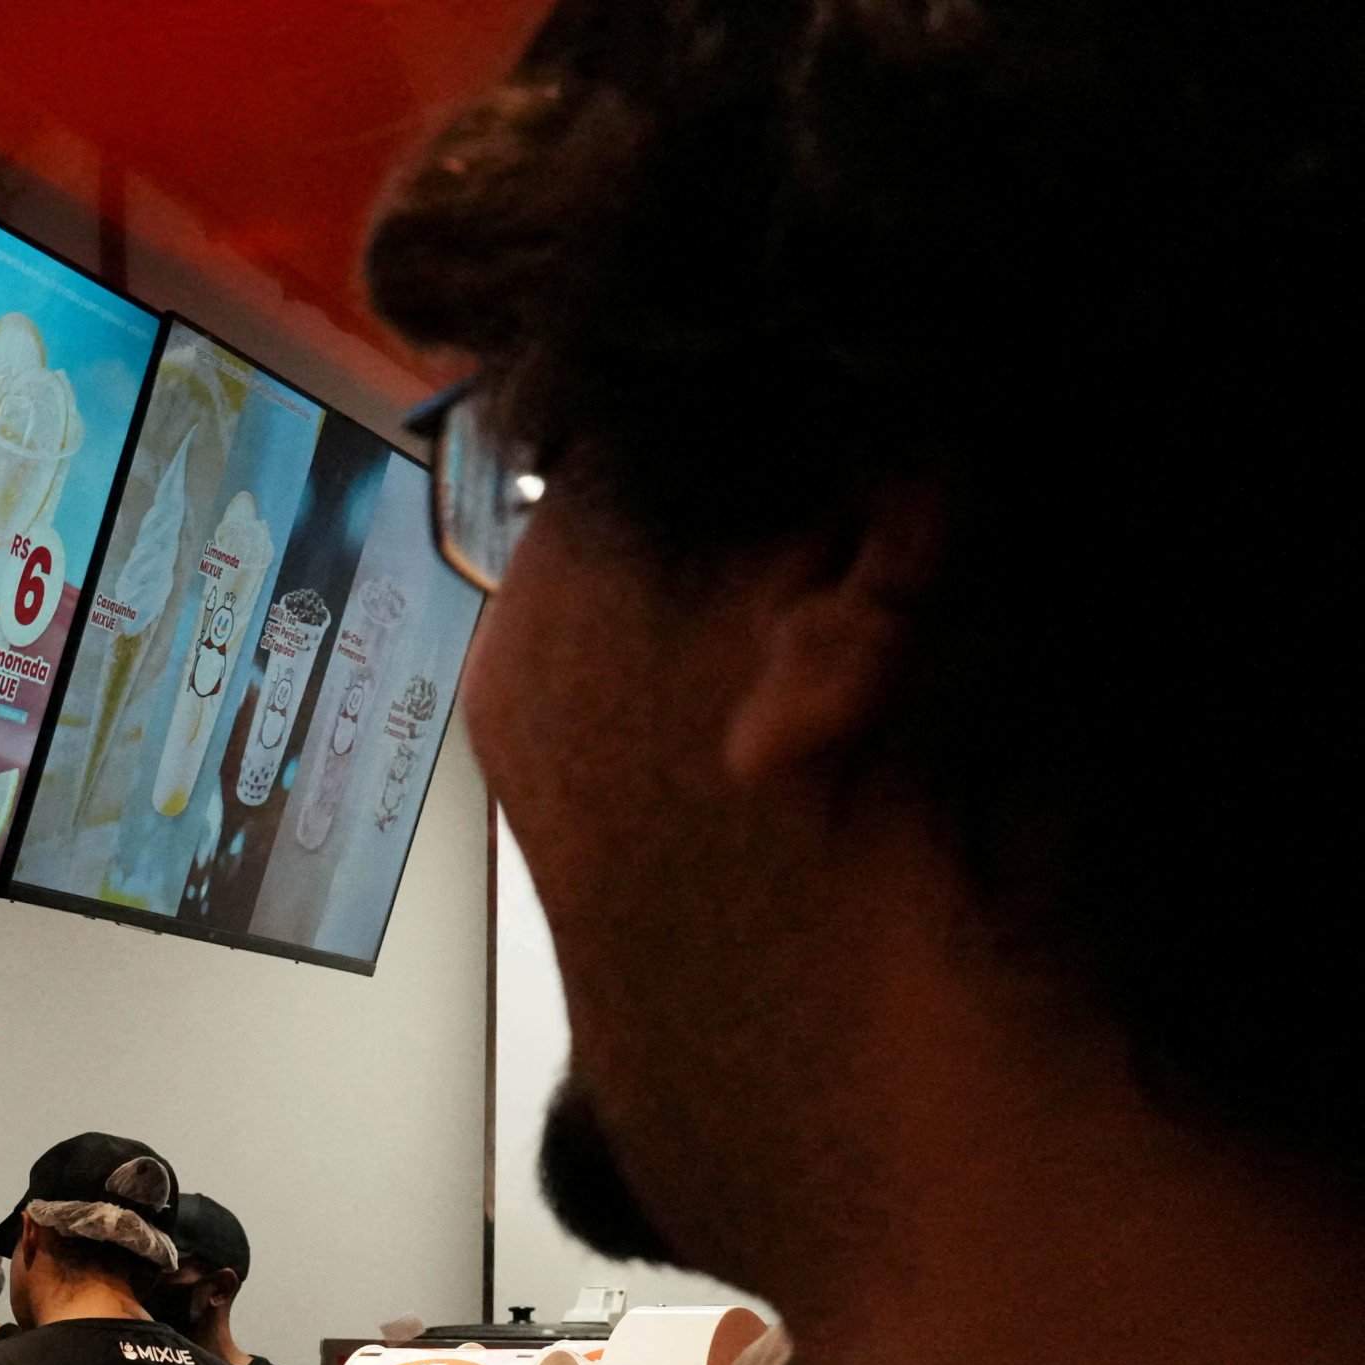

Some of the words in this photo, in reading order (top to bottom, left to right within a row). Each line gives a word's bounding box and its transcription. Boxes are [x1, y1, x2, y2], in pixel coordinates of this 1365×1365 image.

[10, 534, 31, 560] R$
[204, 541, 240, 568] Limonada
[200, 560, 223, 579] MIXUE
[14, 546, 52, 626] 6
[96, 594, 137, 620] Casquinha
[91, 611, 116, 630] MIXUE
[136, 1345, 195, 1365] MIXUE
